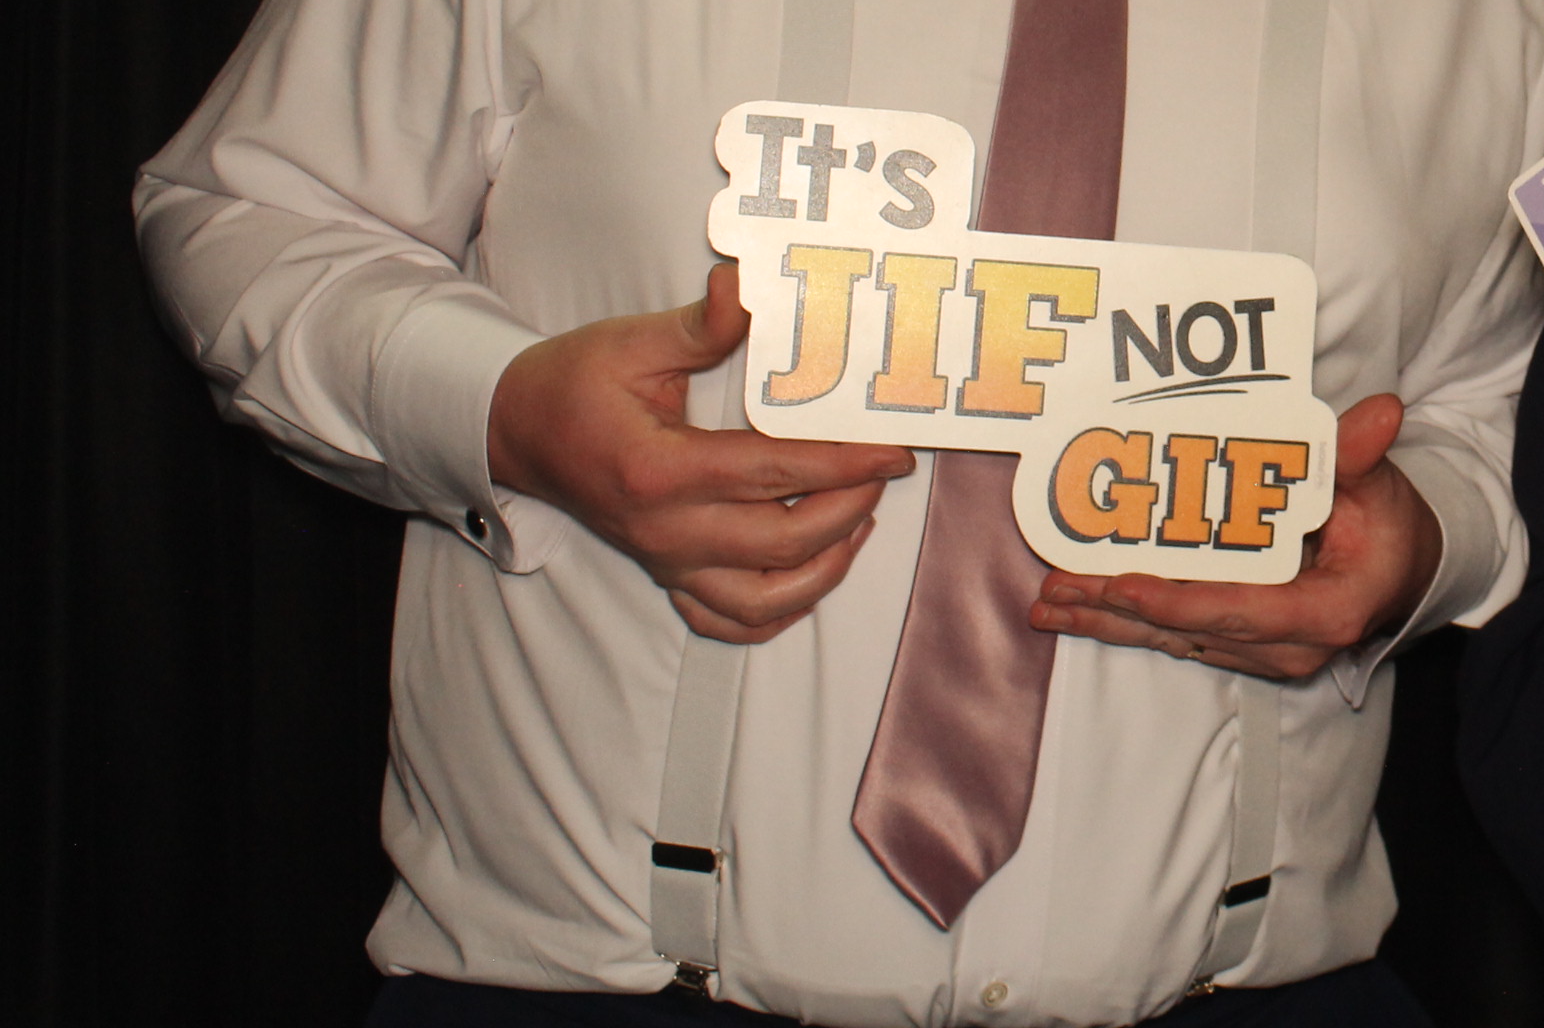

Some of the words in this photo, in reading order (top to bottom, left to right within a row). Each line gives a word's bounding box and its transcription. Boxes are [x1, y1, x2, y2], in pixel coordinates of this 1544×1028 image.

[738, 113, 937, 230] It's
[761, 243, 1100, 420] JIF
[1111, 297, 1275, 382] NOT
[1047, 427, 1310, 552] GIF
